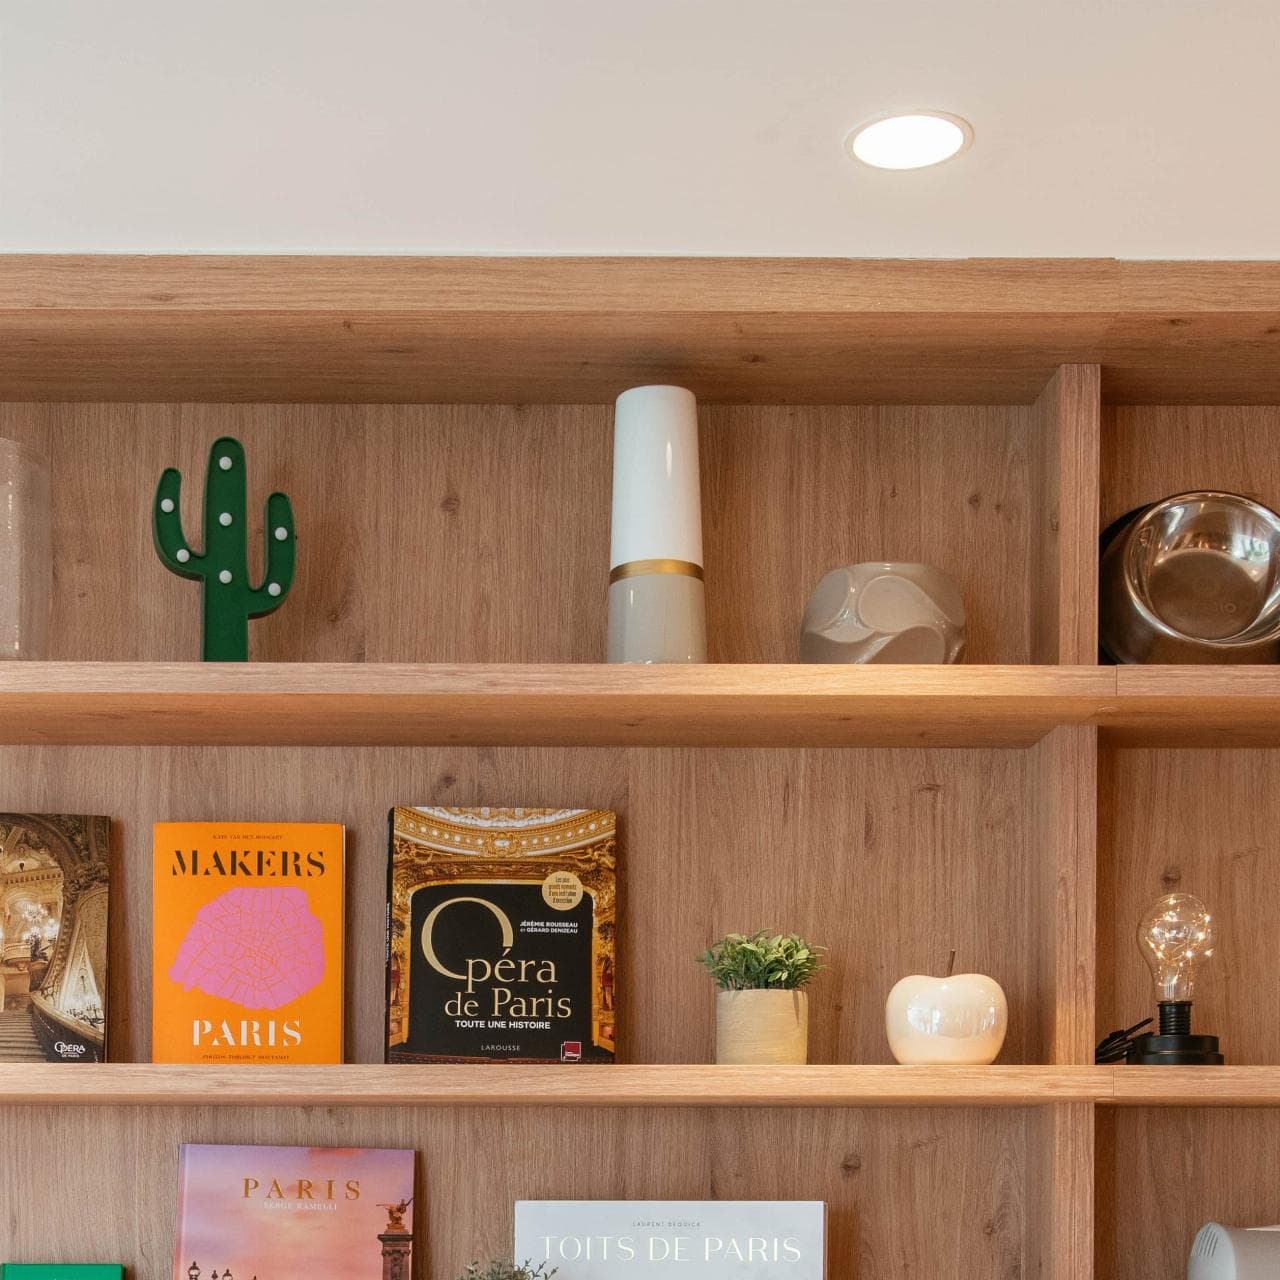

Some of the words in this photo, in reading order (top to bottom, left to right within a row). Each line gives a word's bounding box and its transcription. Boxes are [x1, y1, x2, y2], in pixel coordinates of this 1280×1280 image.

[172, 850, 325, 877] MAKERS
[421, 897, 558, 994] Opéra
[444, 992, 479, 1017] de
[491, 988, 573, 1018] Paris
[192, 1019, 302, 1047] PARIS
[455, 1020, 485, 1028] TOUTE
[488, 1021, 507, 1029] UNE
[509, 1021, 551, 1030] HISTOIRE
[242, 1178, 360, 1200] PARIS
[538, 1236, 635, 1261] TOITS
[649, 1237, 691, 1261] DE
[705, 1237, 801, 1262] PARIS
